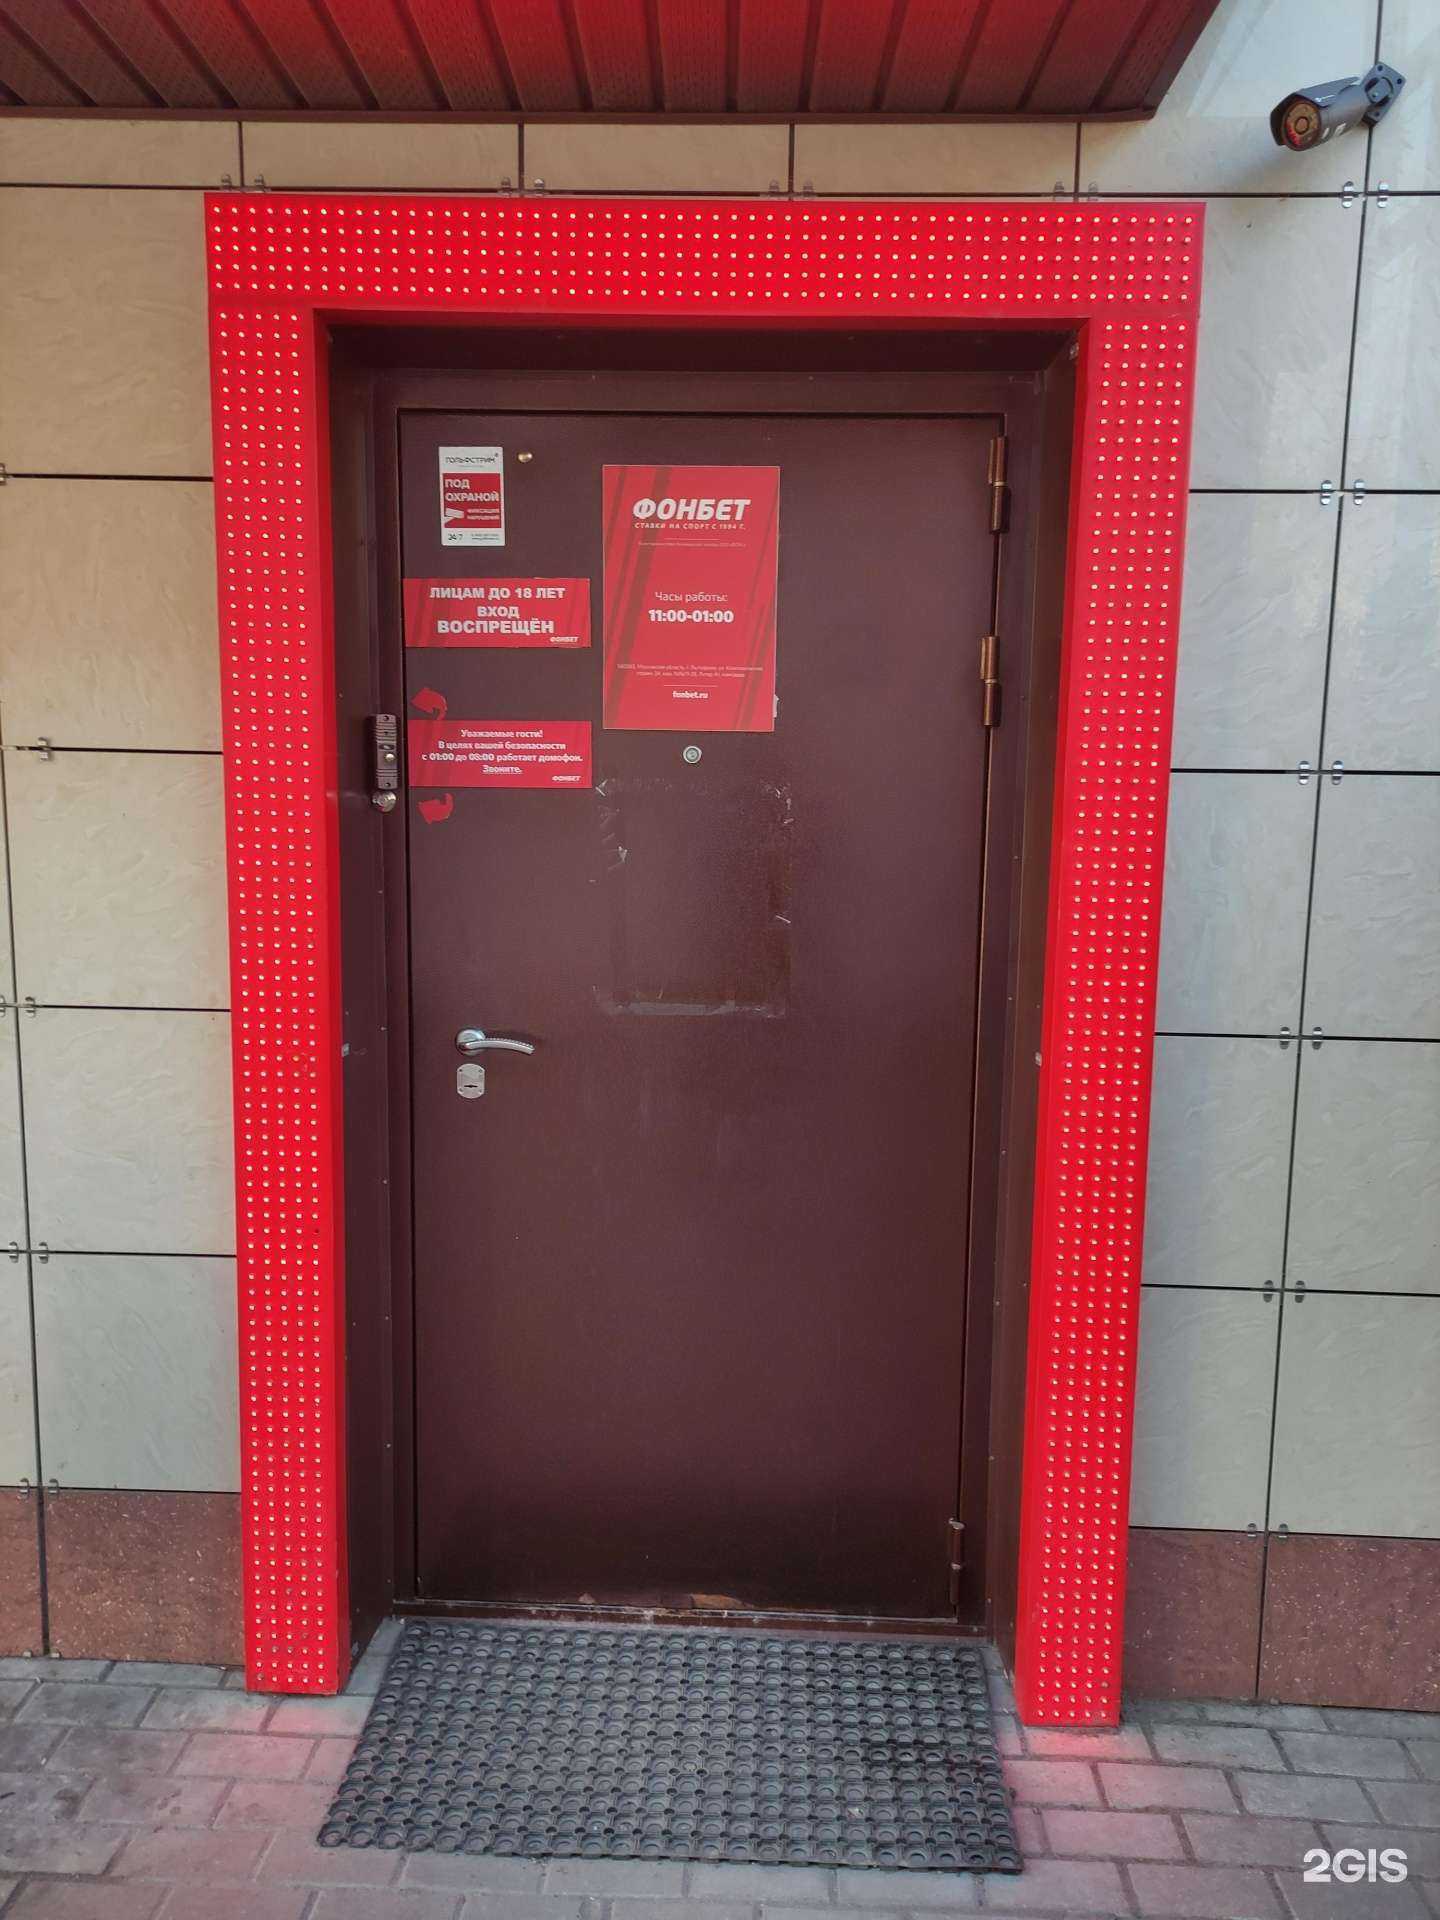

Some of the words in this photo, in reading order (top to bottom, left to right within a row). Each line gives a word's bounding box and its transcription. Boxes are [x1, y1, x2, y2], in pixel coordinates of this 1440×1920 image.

[445, 479, 470, 489] ПОД
[445, 491, 499, 502] ОХРАНОЙ
[633, 498, 751, 521] ФОНБЕТ
[430, 587, 485, 600] ЛИЦАМ
[488, 587, 511, 600] ДО
[515, 587, 532, 599] 18
[535, 587, 566, 599] ЛЕТ
[655, 591, 682, 602] Часы
[685, 592, 728, 604] работы:
[477, 606, 520, 618] ВХОД
[648, 609, 734, 623] 11:00-01:00
[437, 617, 555, 635] ВОСПРЕЩЁН
[672, 690, 708, 699] fonbet.ru
[461, 729, 514, 739] Уважаемые
[515, 729, 543, 739] гости!
[438, 741, 446, 749] В
[447, 742, 473, 751] целях
[505, 741, 566, 750] безопасности
[455, 754, 467, 762] до
[496, 753, 537, 763] работает
